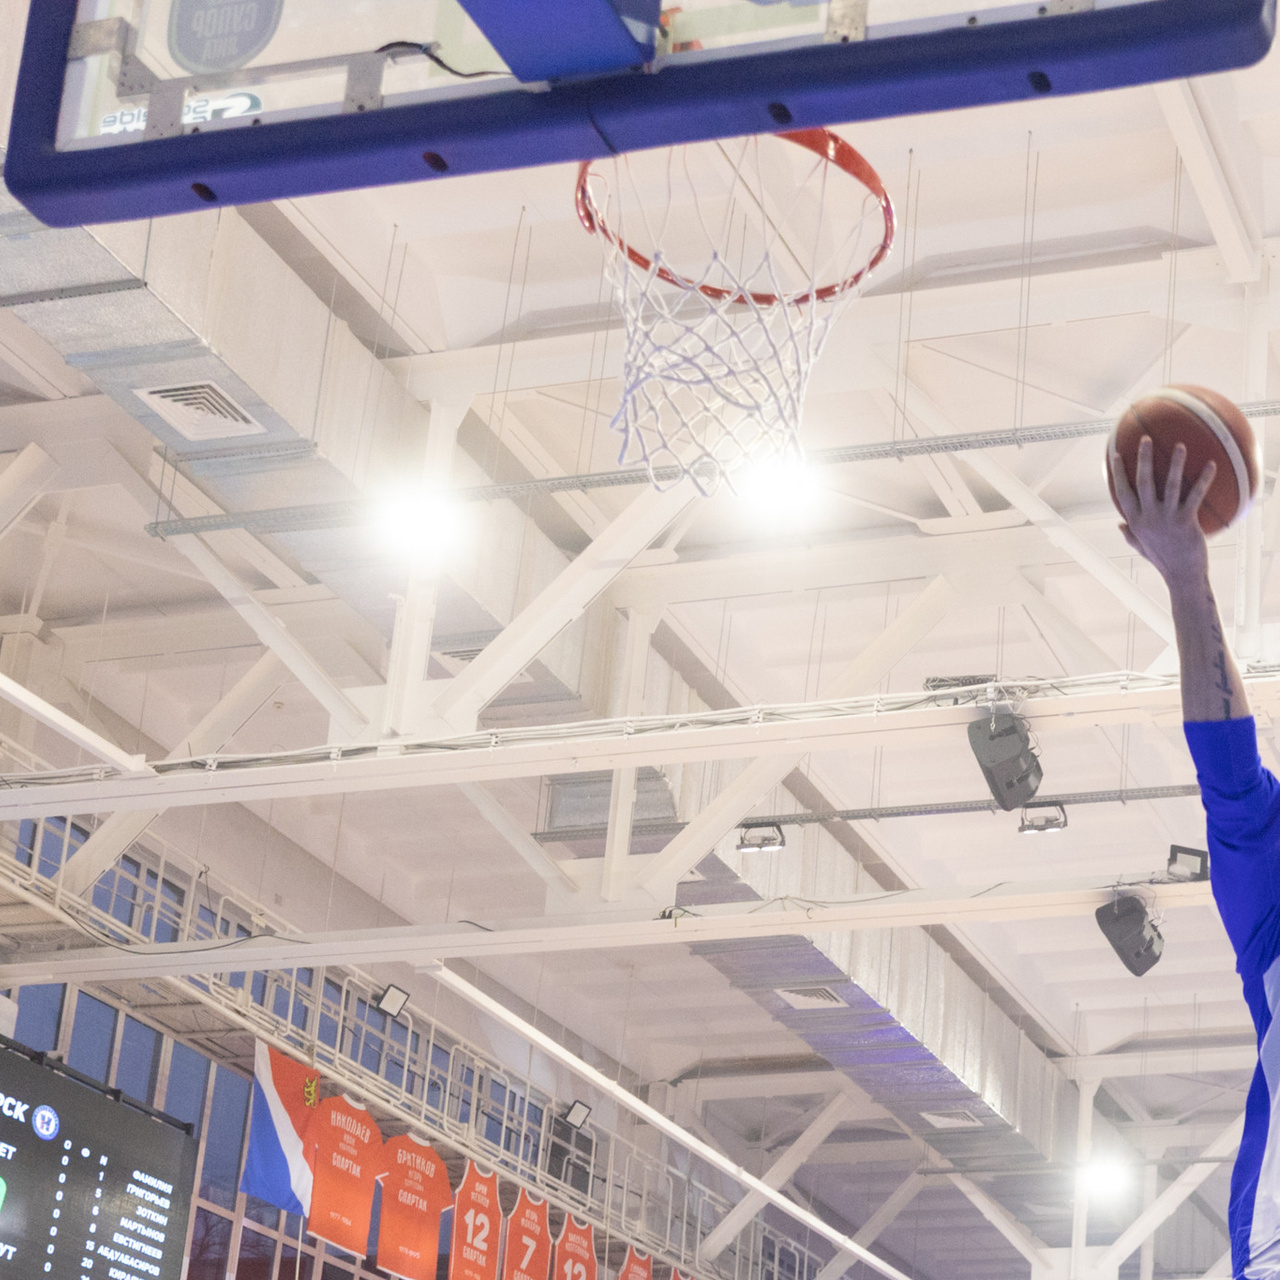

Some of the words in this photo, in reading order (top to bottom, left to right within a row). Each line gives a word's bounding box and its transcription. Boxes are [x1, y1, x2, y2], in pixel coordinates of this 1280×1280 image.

[331, 1110, 371, 1143] НИКОЛАЕВ
[332, 1152, 361, 1178] СПАРТАК
[132, 1170, 173, 1195] ФАМИЛИЯ
[126, 1183, 170, 1209] ГРИГОРЬЕВ
[398, 1189, 427, 1212] СПАРТАК
[136, 1206, 168, 1226] ЗОТКИН
[120, 1217, 165, 1243] МАРТЫНОВ
[464, 1208, 490, 1251] 12
[113, 1232, 163, 1259] ЕВСТИГНЕЕВ
[462, 1245, 486, 1267] СПАРТАК
[520, 1235, 537, 1270] 7
